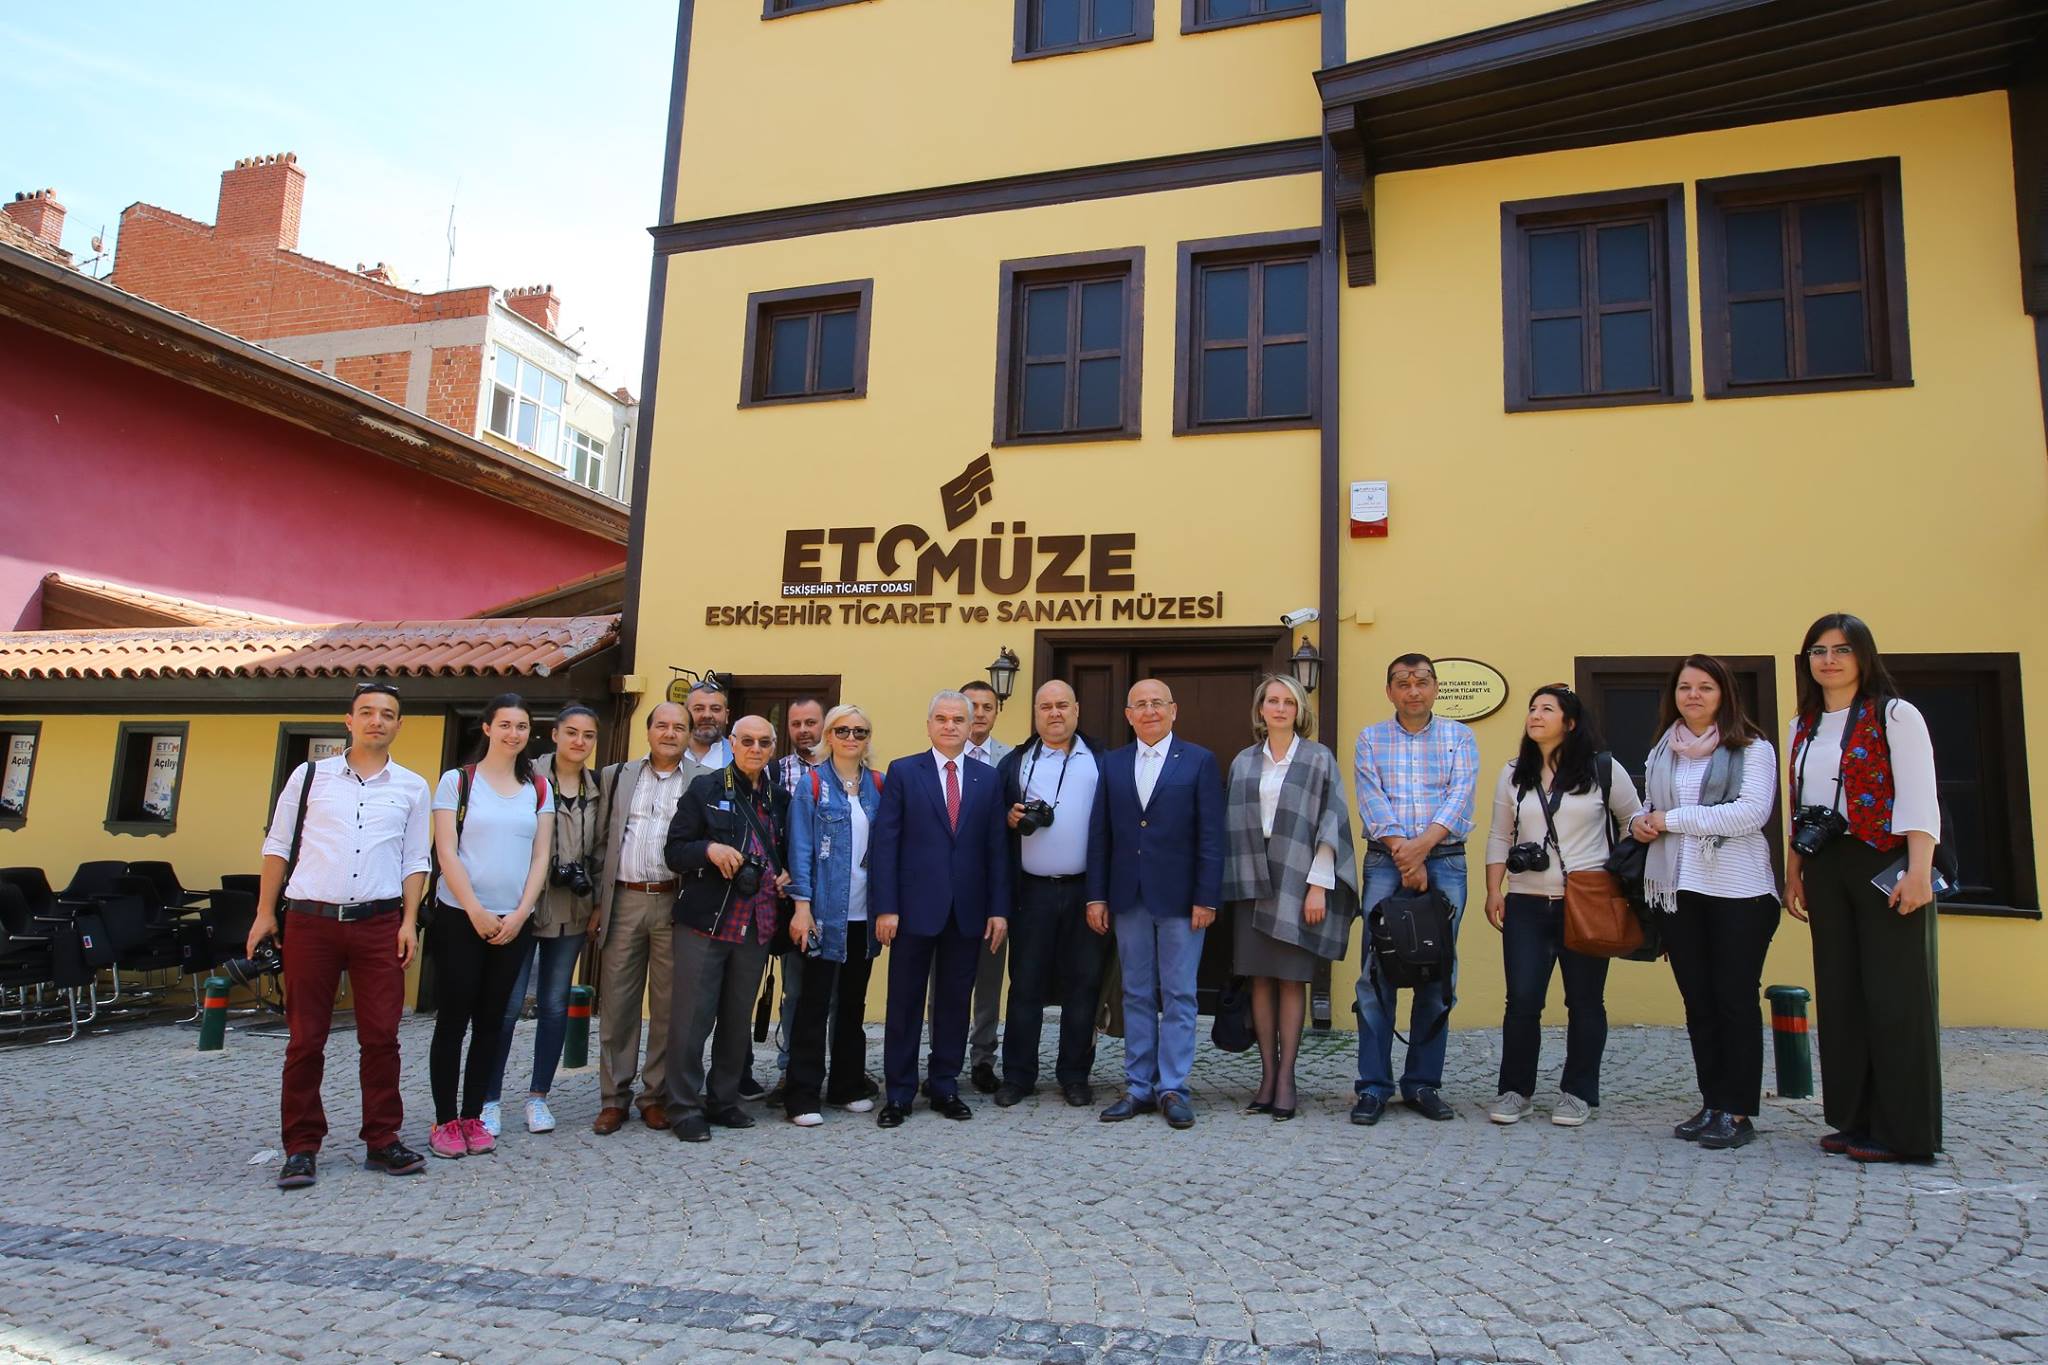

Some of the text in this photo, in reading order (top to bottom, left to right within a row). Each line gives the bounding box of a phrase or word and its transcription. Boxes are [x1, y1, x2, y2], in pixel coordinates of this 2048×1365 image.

[783, 582, 913, 596] ESKİŞEHİR TİCARET ODASI
[705, 591, 1223, 630] ESKİŞEHİR TİCARET ve SANAYİ MÜZESİ
